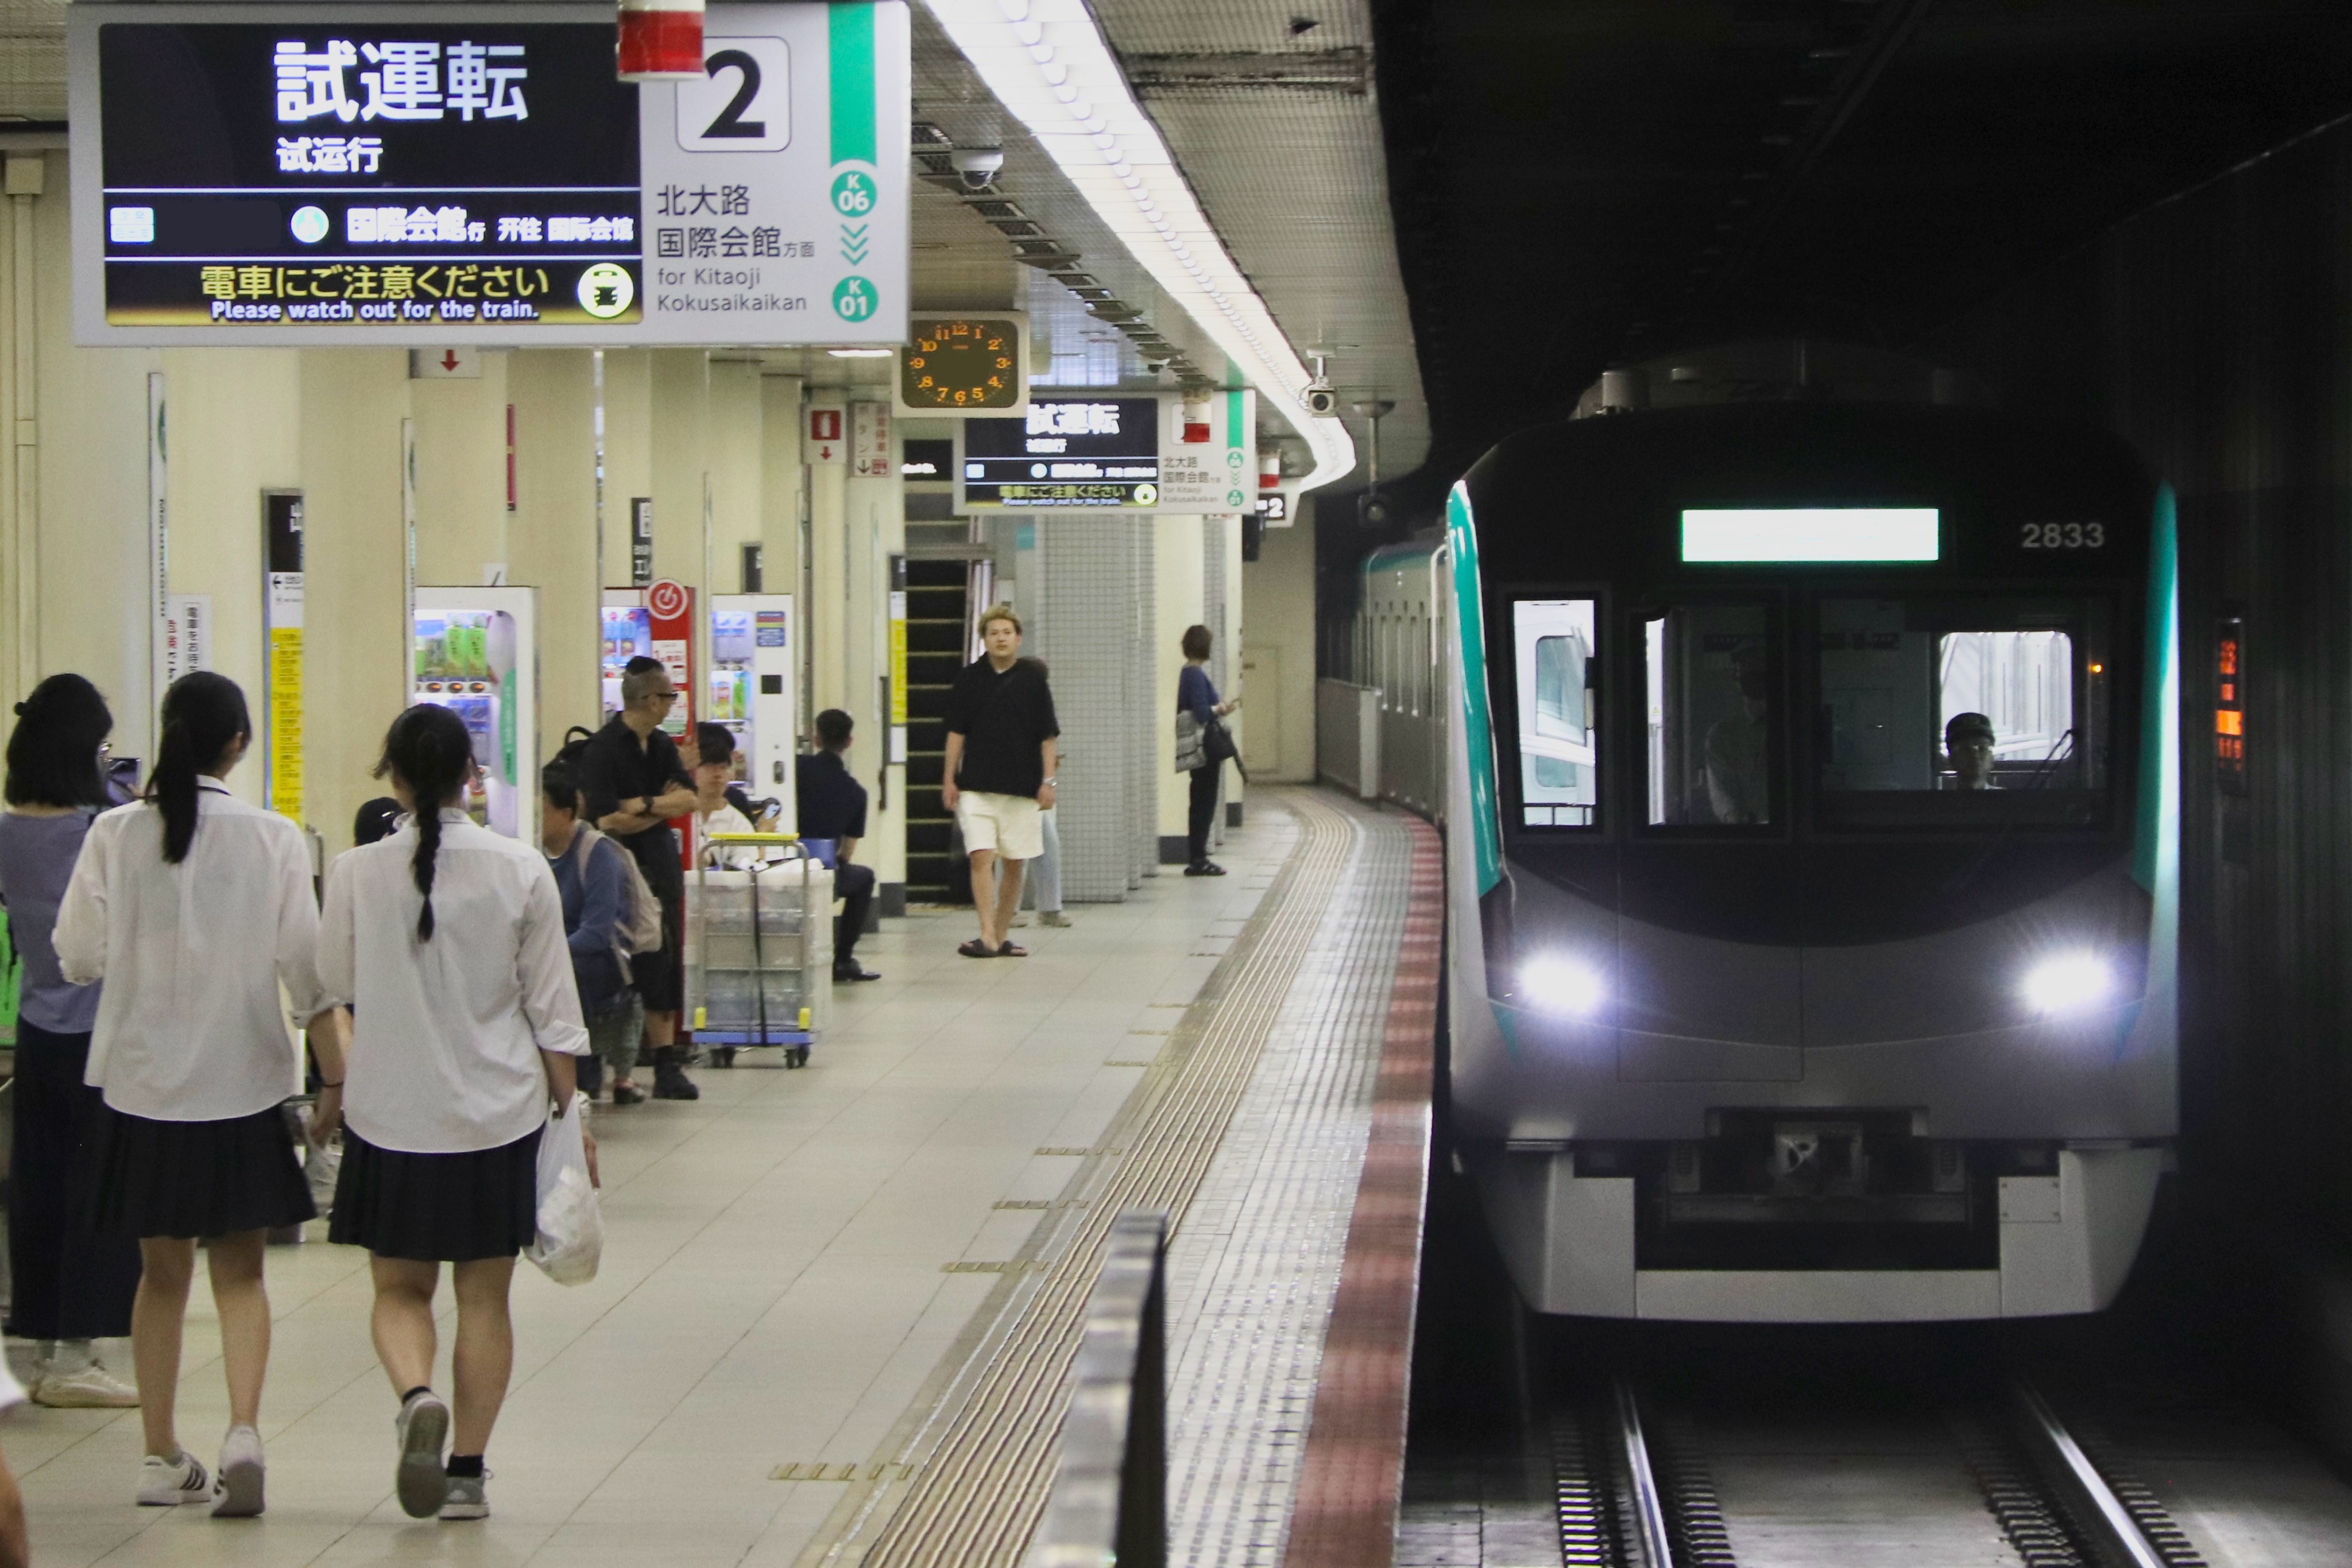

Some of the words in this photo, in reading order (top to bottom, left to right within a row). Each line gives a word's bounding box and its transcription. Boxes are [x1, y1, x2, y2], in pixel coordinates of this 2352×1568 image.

[274, 40, 528, 122] 試運転
[701, 49, 765, 138] 2
[276, 137, 383, 172] 试运行
[848, 175, 860, 189] K
[657, 184, 750, 216] 北大路
[838, 191, 869, 212] 06
[657, 226, 815, 258] 国際会館方面
[201, 265, 548, 300] 電車にご注意ください
[658, 268, 686, 285] for
[695, 268, 761, 289] Kitaoji
[849, 280, 861, 294] K
[212, 301, 281, 319] Please
[288, 300, 353, 319] watch
[360, 301, 396, 319] out
[403, 300, 434, 318] for
[440, 300, 475, 318] the
[482, 300, 539, 318] train.
[658, 294, 806, 311] Kokusaikaikan
[840, 296, 868, 317] 01
[952, 324, 968, 335] 12
[922, 340, 937, 352] 10
[988, 339, 999, 350] 2
[915, 357, 925, 369] 9
[996, 357, 1007, 369] 3
[922, 375, 933, 387] 8
[988, 375, 1000, 386] 4
[938, 388, 949, 398] 7
[954, 390, 966, 402] 6
[972, 388, 983, 398] 5
[1268, 498, 1283, 517] 2
[2022, 522, 2104, 548] 2833
